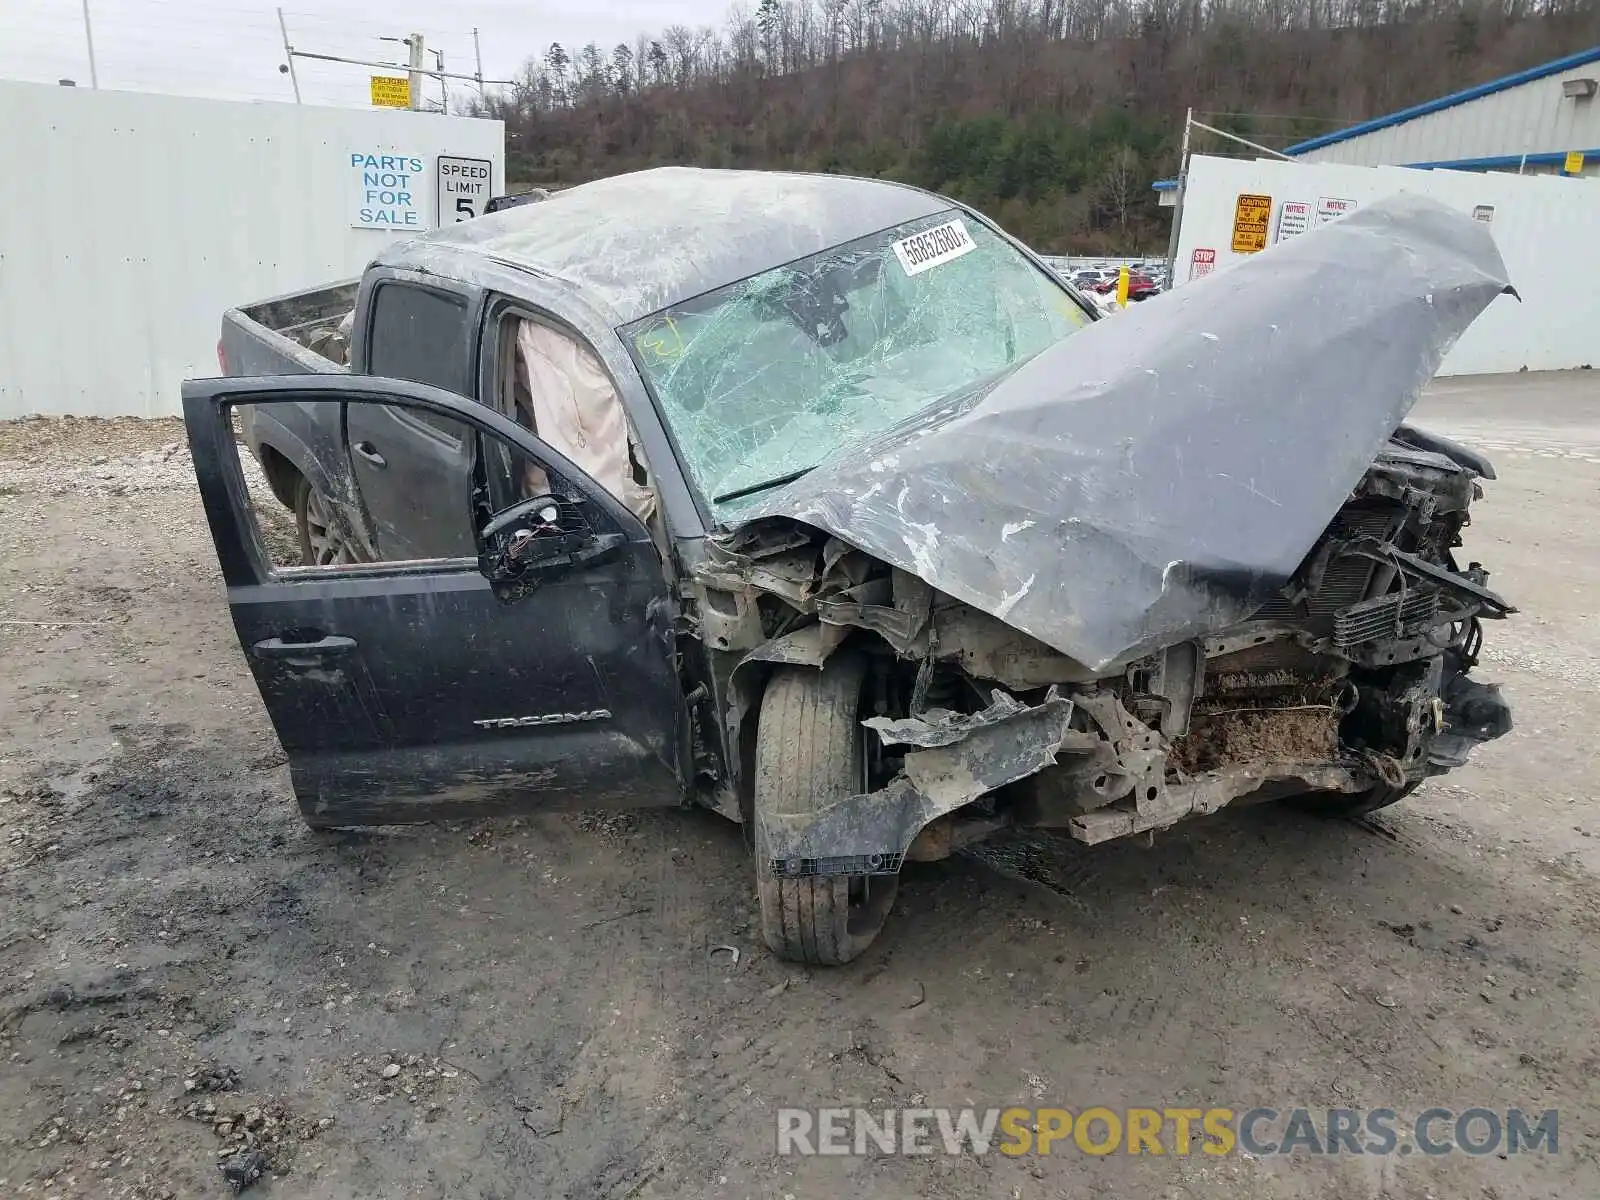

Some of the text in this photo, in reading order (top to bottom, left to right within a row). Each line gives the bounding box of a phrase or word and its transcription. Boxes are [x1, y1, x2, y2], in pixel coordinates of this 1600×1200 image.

[351, 154, 423, 172] PARTS
[441, 165, 488, 178] SPEED
[364, 173, 410, 188] NOT
[446, 181, 483, 194] LIMIT
[366, 190, 412, 206] FOR
[1241, 198, 1269, 208] CAUTION
[1326, 201, 1347, 209] NOTICE
[360, 208, 417, 224] SALE
[456, 198, 475, 222] 5
[1285, 204, 1305, 213] NOTICE
[902, 225, 962, 265] 56852680
[1195, 250, 1214, 262] STOP
[473, 709, 612, 729] TACOMA
